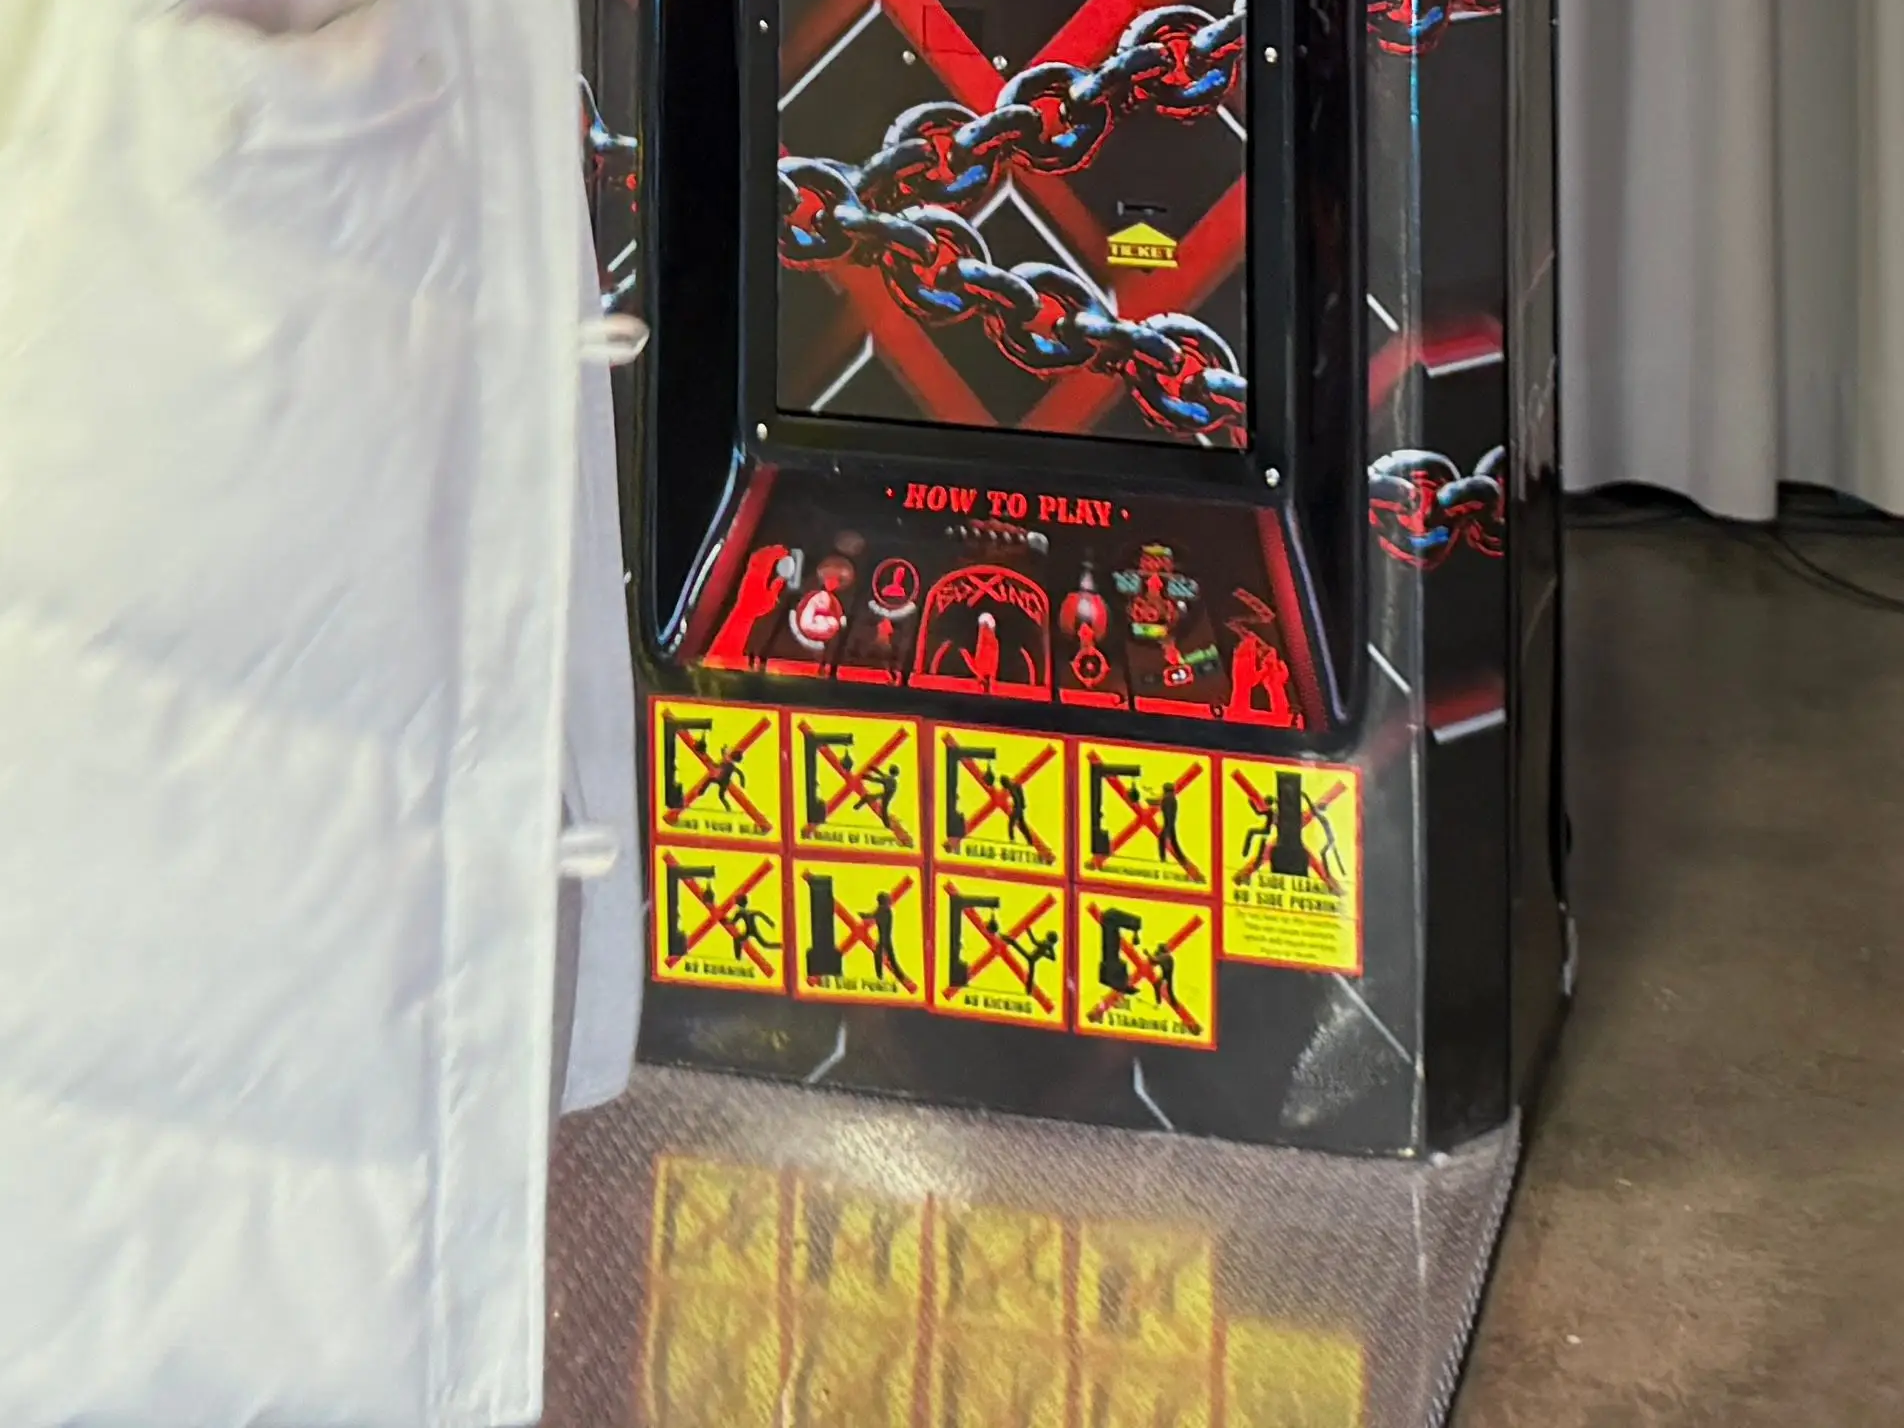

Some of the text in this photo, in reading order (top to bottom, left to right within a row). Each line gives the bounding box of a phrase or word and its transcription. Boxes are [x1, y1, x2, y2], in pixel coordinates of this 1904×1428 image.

[1109, 244, 1175, 258] TICKET
[903, 482, 1113, 528] HOW TO PLAY
